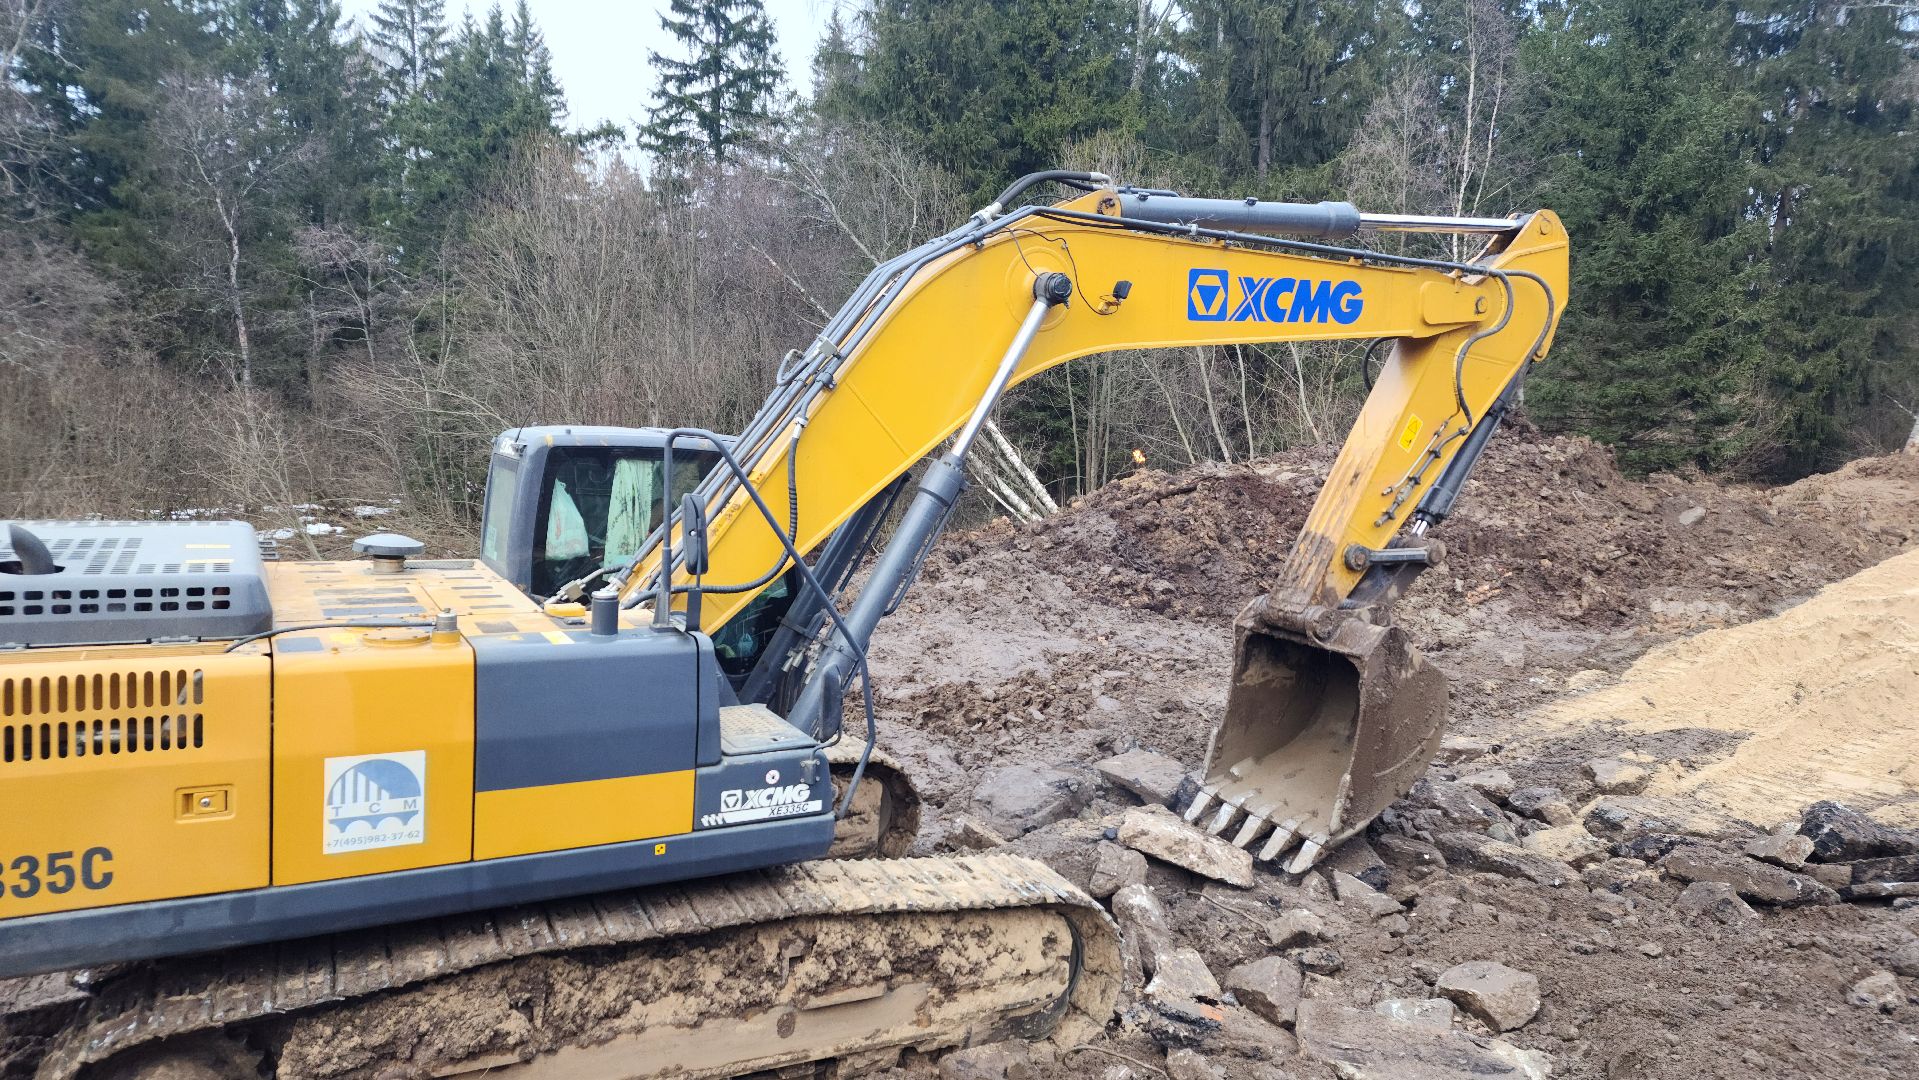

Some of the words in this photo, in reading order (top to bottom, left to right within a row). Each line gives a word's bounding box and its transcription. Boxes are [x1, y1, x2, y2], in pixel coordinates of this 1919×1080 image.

[1227, 276, 1364, 325] XCMG
[741, 783, 811, 810] XCMG
[768, 802, 809, 817] XE335C
[0, 846, 114, 899] 35C
